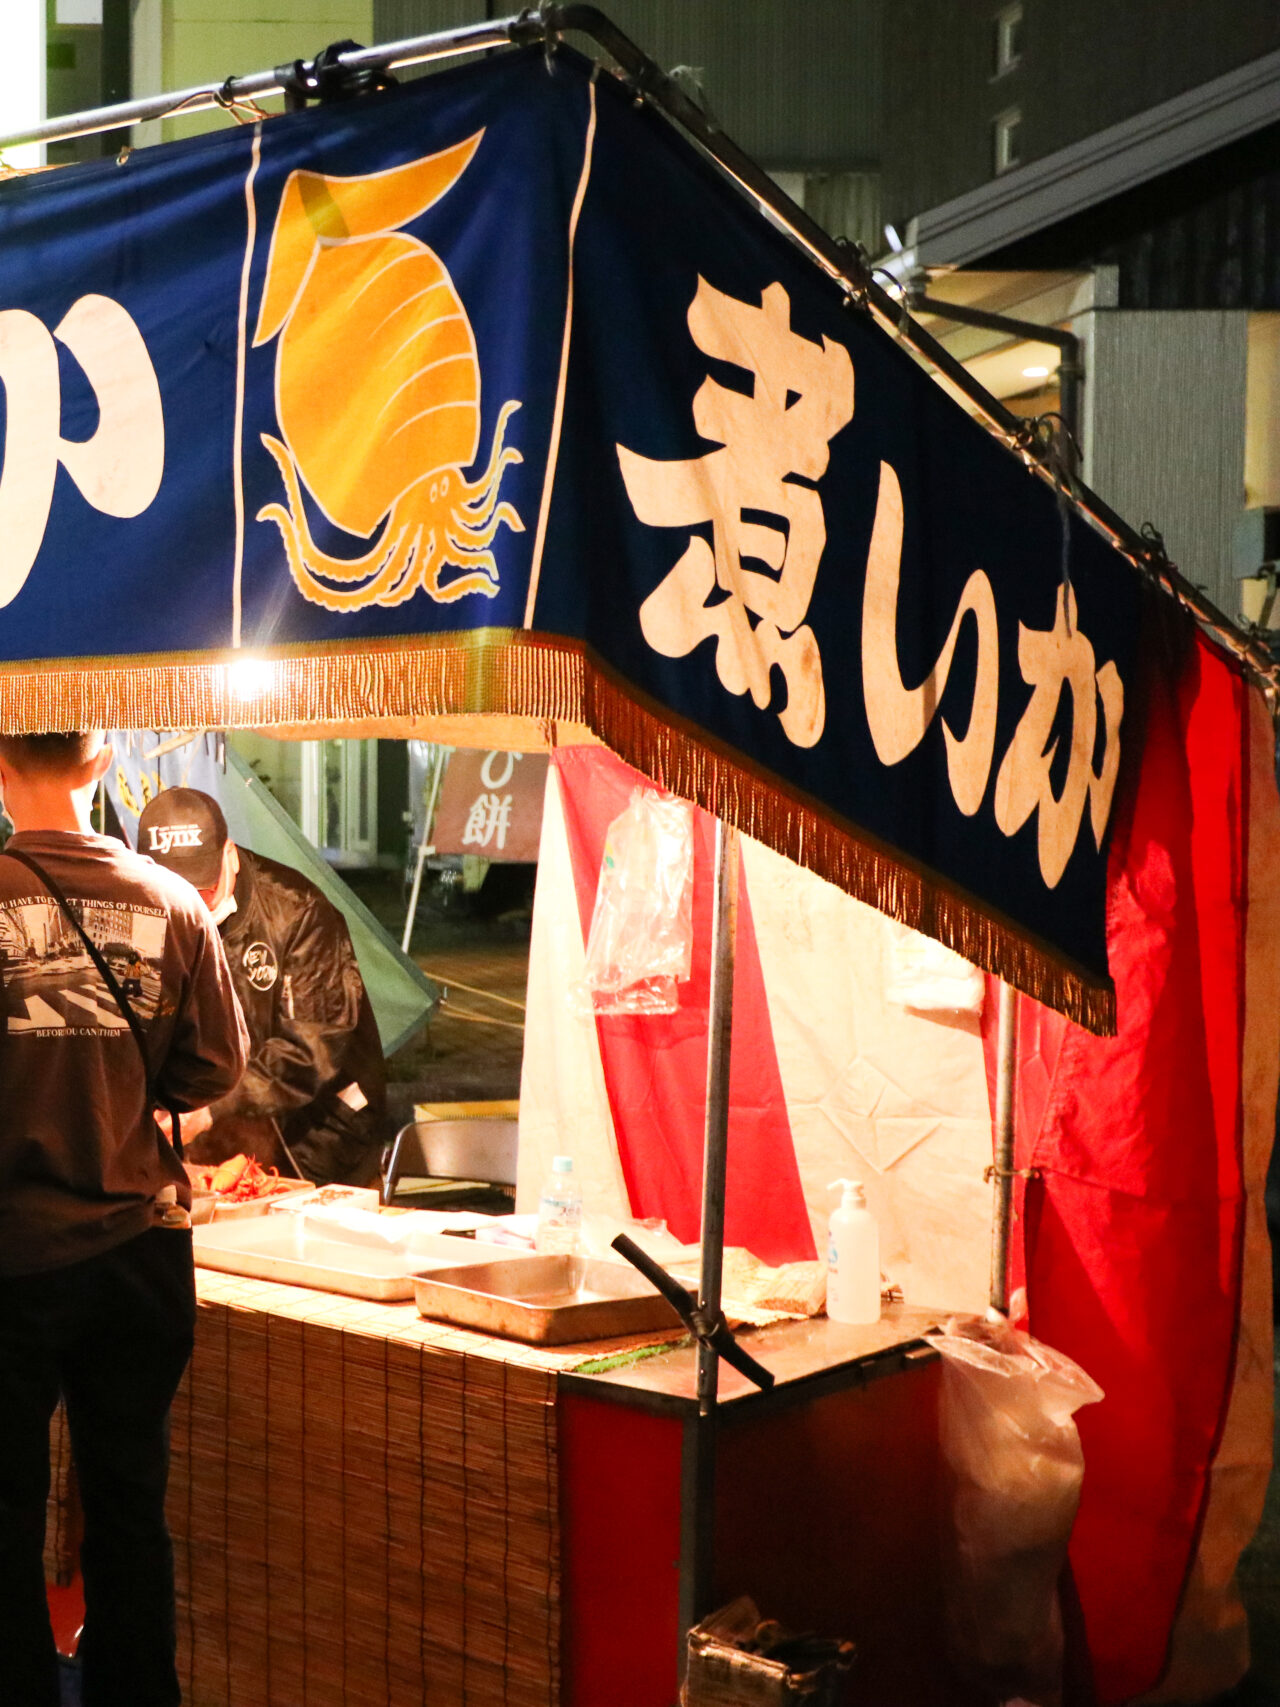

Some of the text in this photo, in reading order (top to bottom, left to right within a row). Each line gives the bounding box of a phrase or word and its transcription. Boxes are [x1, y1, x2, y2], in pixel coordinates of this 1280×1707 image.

[616, 273, 1123, 889] 煮いか
[148, 826, 203, 854] Lynx
[9, 897, 33, 908] HAVE
[34, 896, 47, 904] TO
[47, 897, 78, 906] EXCT
[81, 899, 114, 909] THINGS
[116, 902, 127, 911] OF
[36, 1029, 64, 1038] BEFOR
[79, 1028, 97, 1036] CAN
[99, 1029, 121, 1038] THEM
